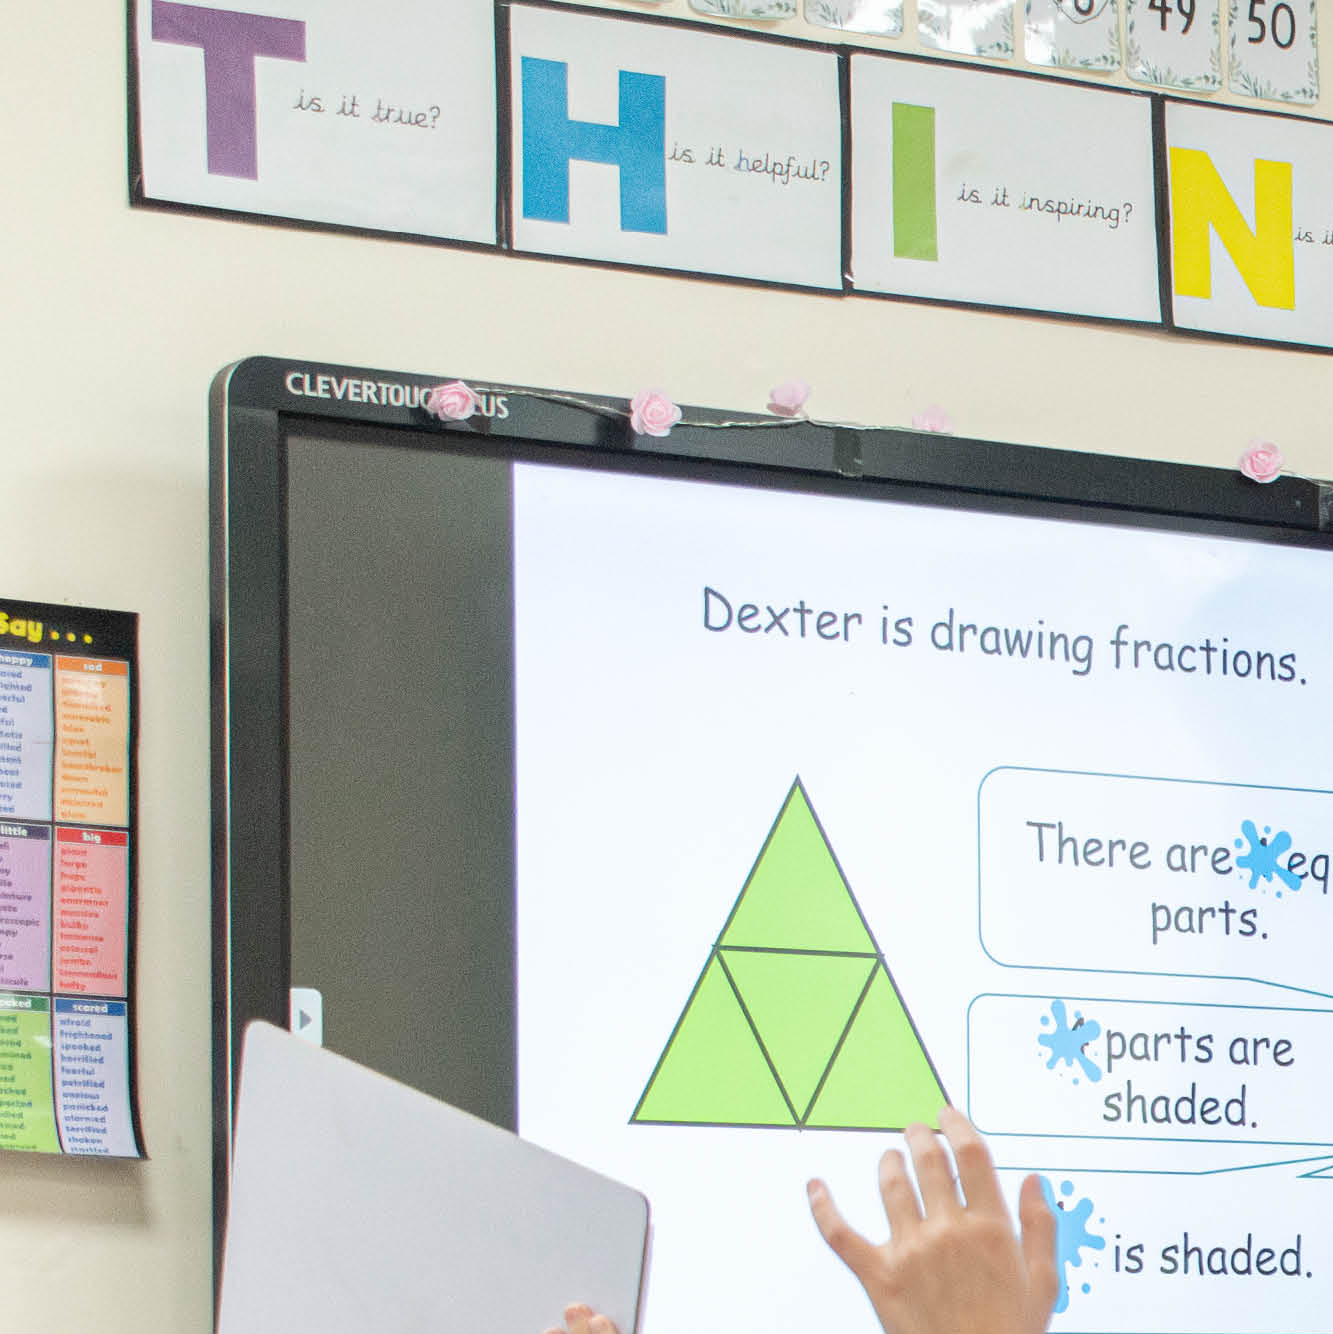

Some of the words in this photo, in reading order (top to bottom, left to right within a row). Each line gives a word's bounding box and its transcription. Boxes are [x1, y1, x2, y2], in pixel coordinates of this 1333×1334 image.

[1247, 2, 1296, 49] 50
[152, 0, 306, 181] T
[293, 90, 324, 115] is
[337, 94, 361, 120] it
[371, 97, 441, 130] true?
[522, 56, 667, 236] H
[669, 144, 696, 165] is
[705, 145, 727, 170] it
[734, 148, 831, 186] helpful?
[892, 102, 938, 262] I
[957, 184, 983, 206] is
[991, 187, 1012, 210] it
[1018, 189, 1134, 231] inspiring?
[1168, 146, 1296, 310] N
[1294, 226, 1316, 245] is
[285, 371, 432, 410] CLEVERTOUC
[702, 585, 863, 643] Dexter
[880, 600, 914, 647] is
[930, 608, 1095, 677] drawing
[1109, 625, 1309, 687] fractions.
[1026, 821, 1152, 870] There
[1166, 841, 1234, 875] are
[1152, 898, 1269, 945] parts.
[1106, 1024, 1214, 1074] parts
[1229, 1034, 1295, 1068] are
[1102, 1080, 1259, 1130] shaded.
[1113, 1233, 1145, 1274] is
[1159, 1229, 1313, 1280] shaded.
